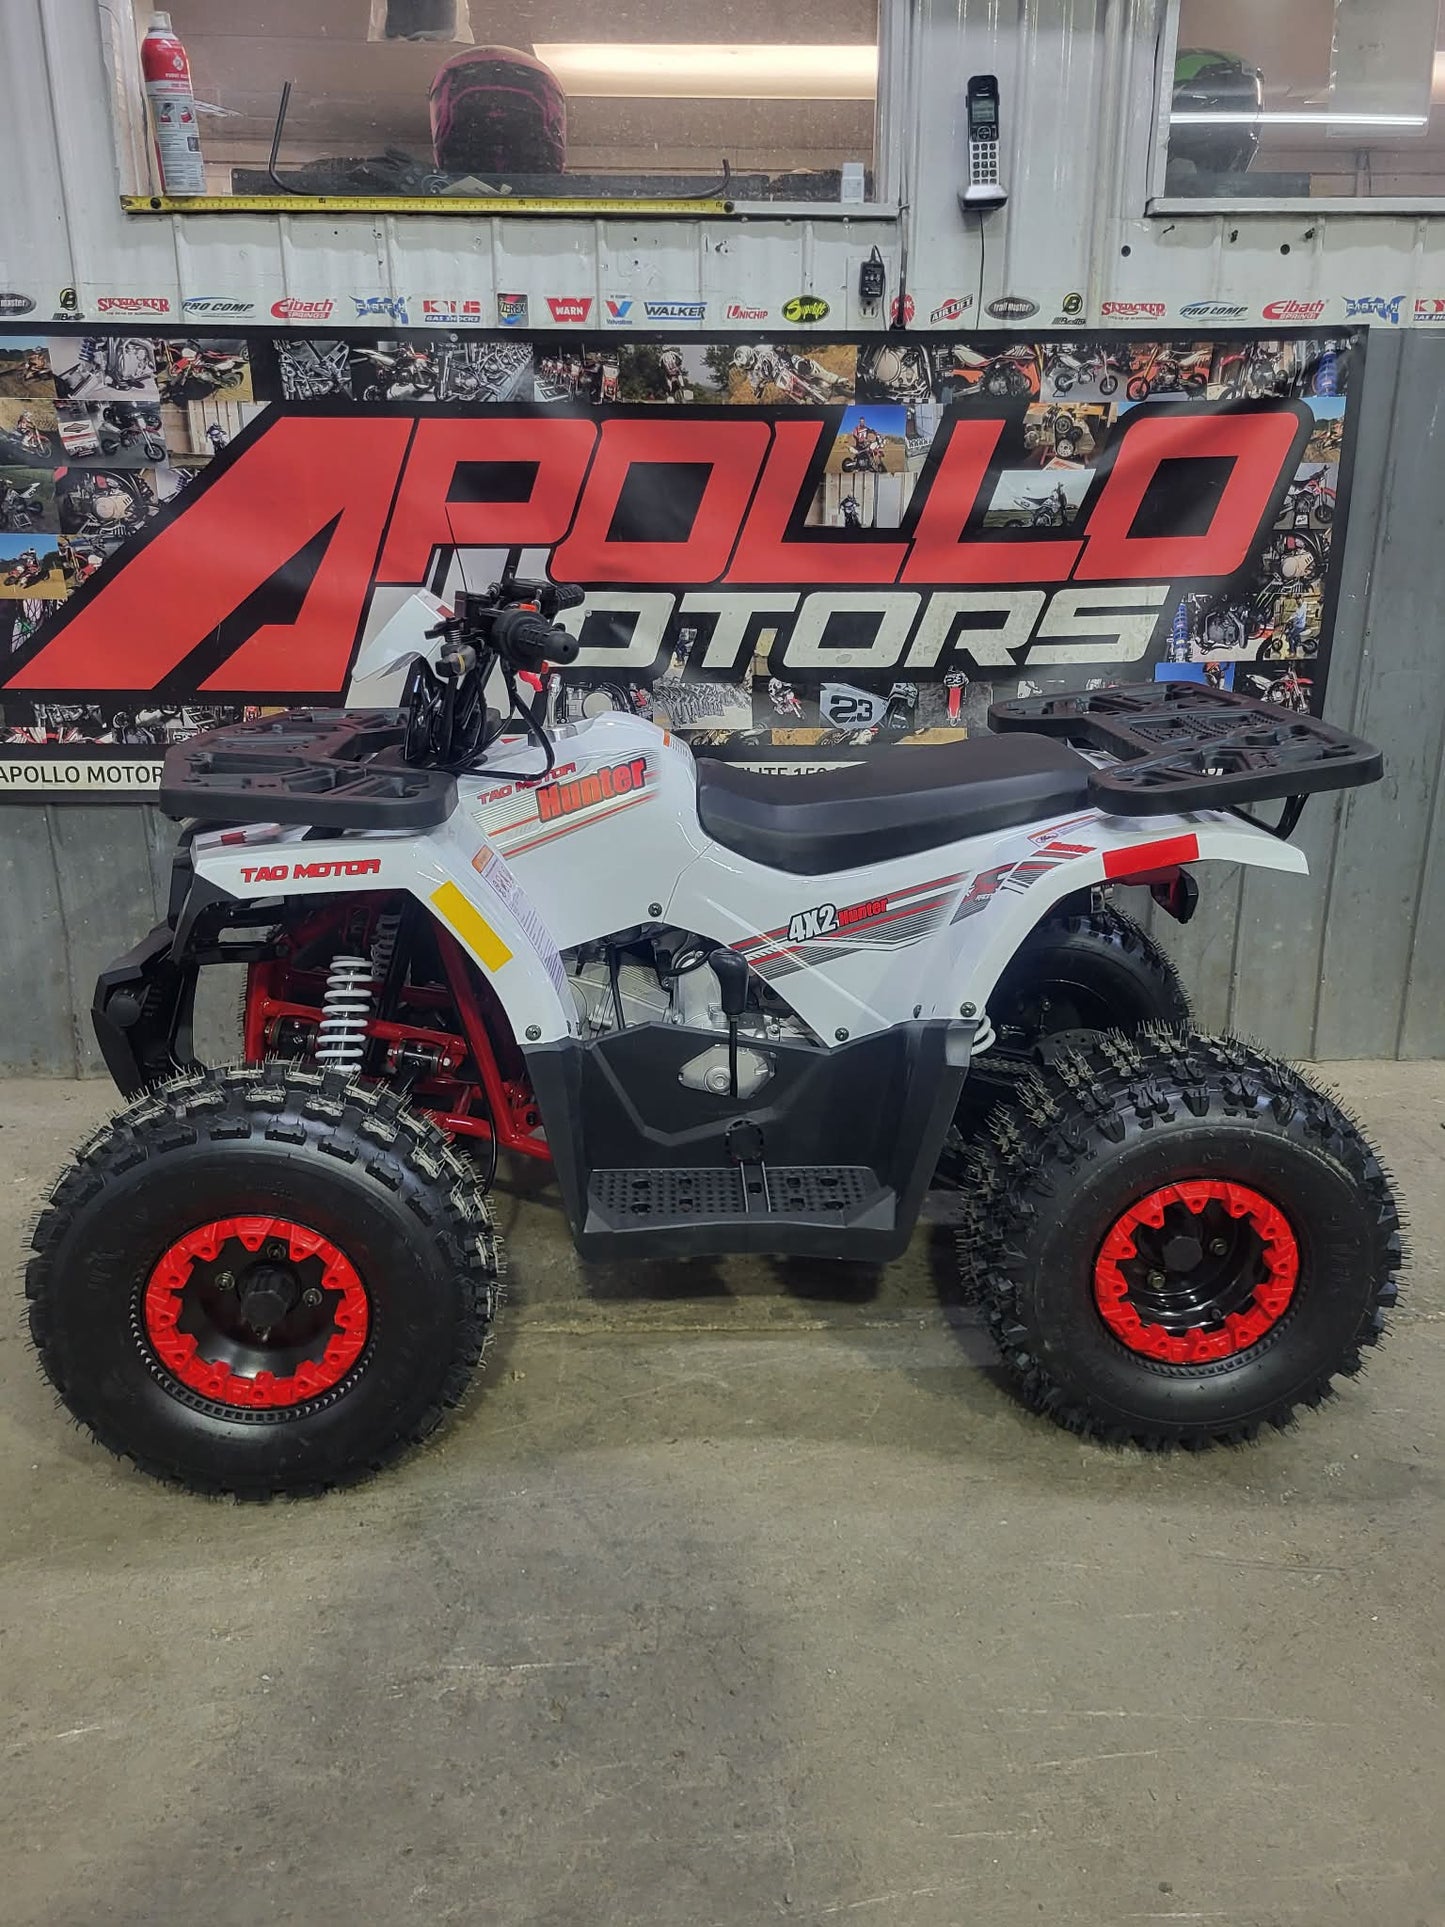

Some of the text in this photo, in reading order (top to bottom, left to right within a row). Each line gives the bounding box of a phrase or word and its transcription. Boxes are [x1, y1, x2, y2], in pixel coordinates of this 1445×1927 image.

[97, 298, 170, 312] SKYJACKER
[182, 302, 254, 312] PRO COMP
[271, 298, 334, 319] Eibach
[501, 303, 526, 314] ZEREX
[556, 306, 584, 316] WARN
[644, 302, 706, 320] WALKER
[930, 296, 974, 322] AIR LIFT
[1101, 301, 1166, 316] SKYJACKER
[1180, 306, 1248, 316] PRO COMP
[1263, 300, 1324, 320] Eibach
[3, 412, 1300, 692] APOLLO
[829, 695, 873, 724] 23
[0, 766, 80, 783] APOLLO
[477, 785, 512, 805] TAO
[535, 757, 647, 823] Hunter
[240, 859, 381, 883] TAO MOTOR
[788, 898, 888, 943] 4X2 Hunter
